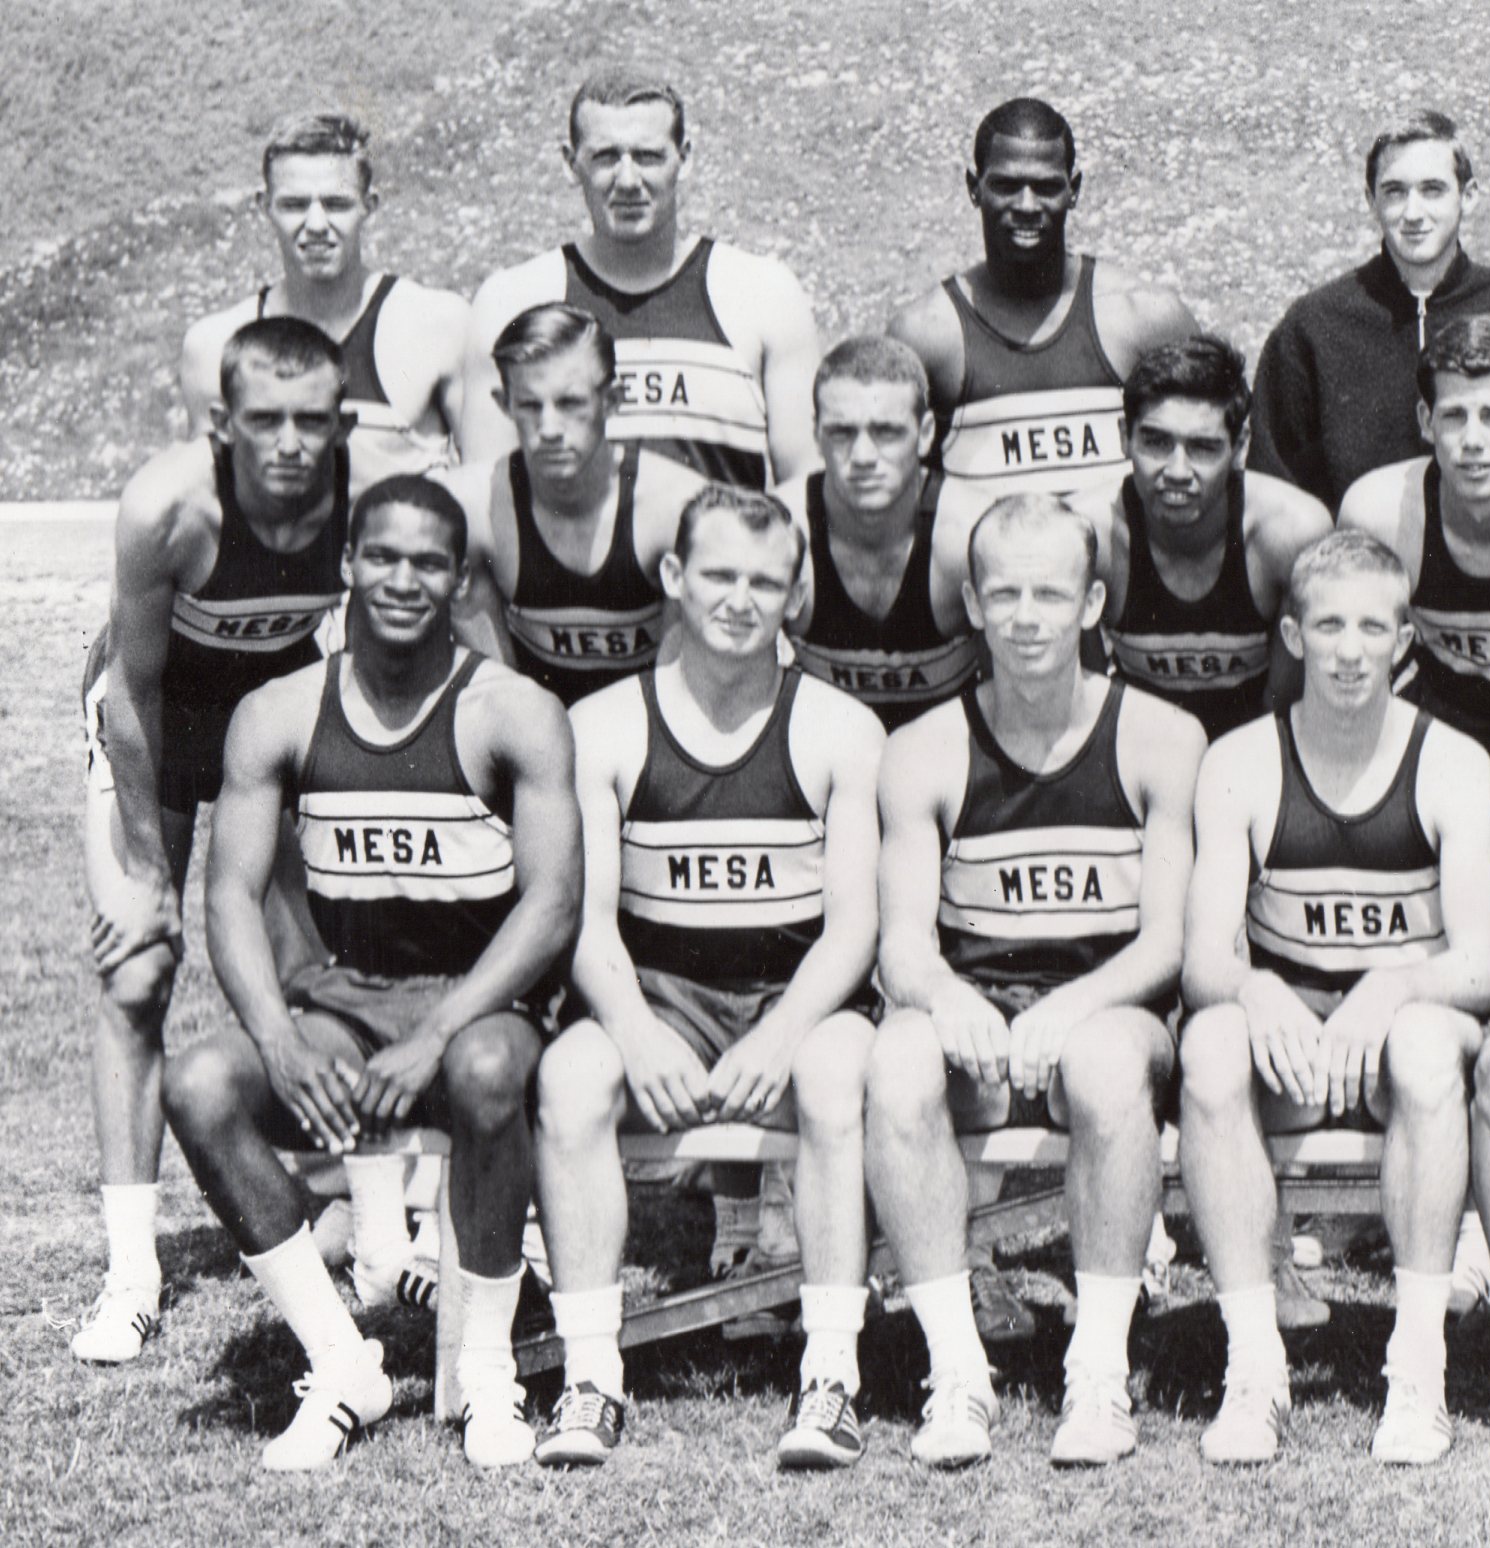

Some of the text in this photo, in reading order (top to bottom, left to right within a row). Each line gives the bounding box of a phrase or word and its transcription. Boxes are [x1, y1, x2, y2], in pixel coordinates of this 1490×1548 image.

[618, 371, 689, 406] ESA
[1002, 422, 1101, 467] MESA
[213, 614, 314, 636] MESA
[547, 624, 657, 656] MESA
[831, 663, 930, 691] MESA
[1147, 650, 1246, 677] MESA
[334, 828, 442, 866] MESA
[668, 855, 775, 890] MESA
[999, 865, 1103, 902] MESA
[1304, 901, 1409, 937] MESA
